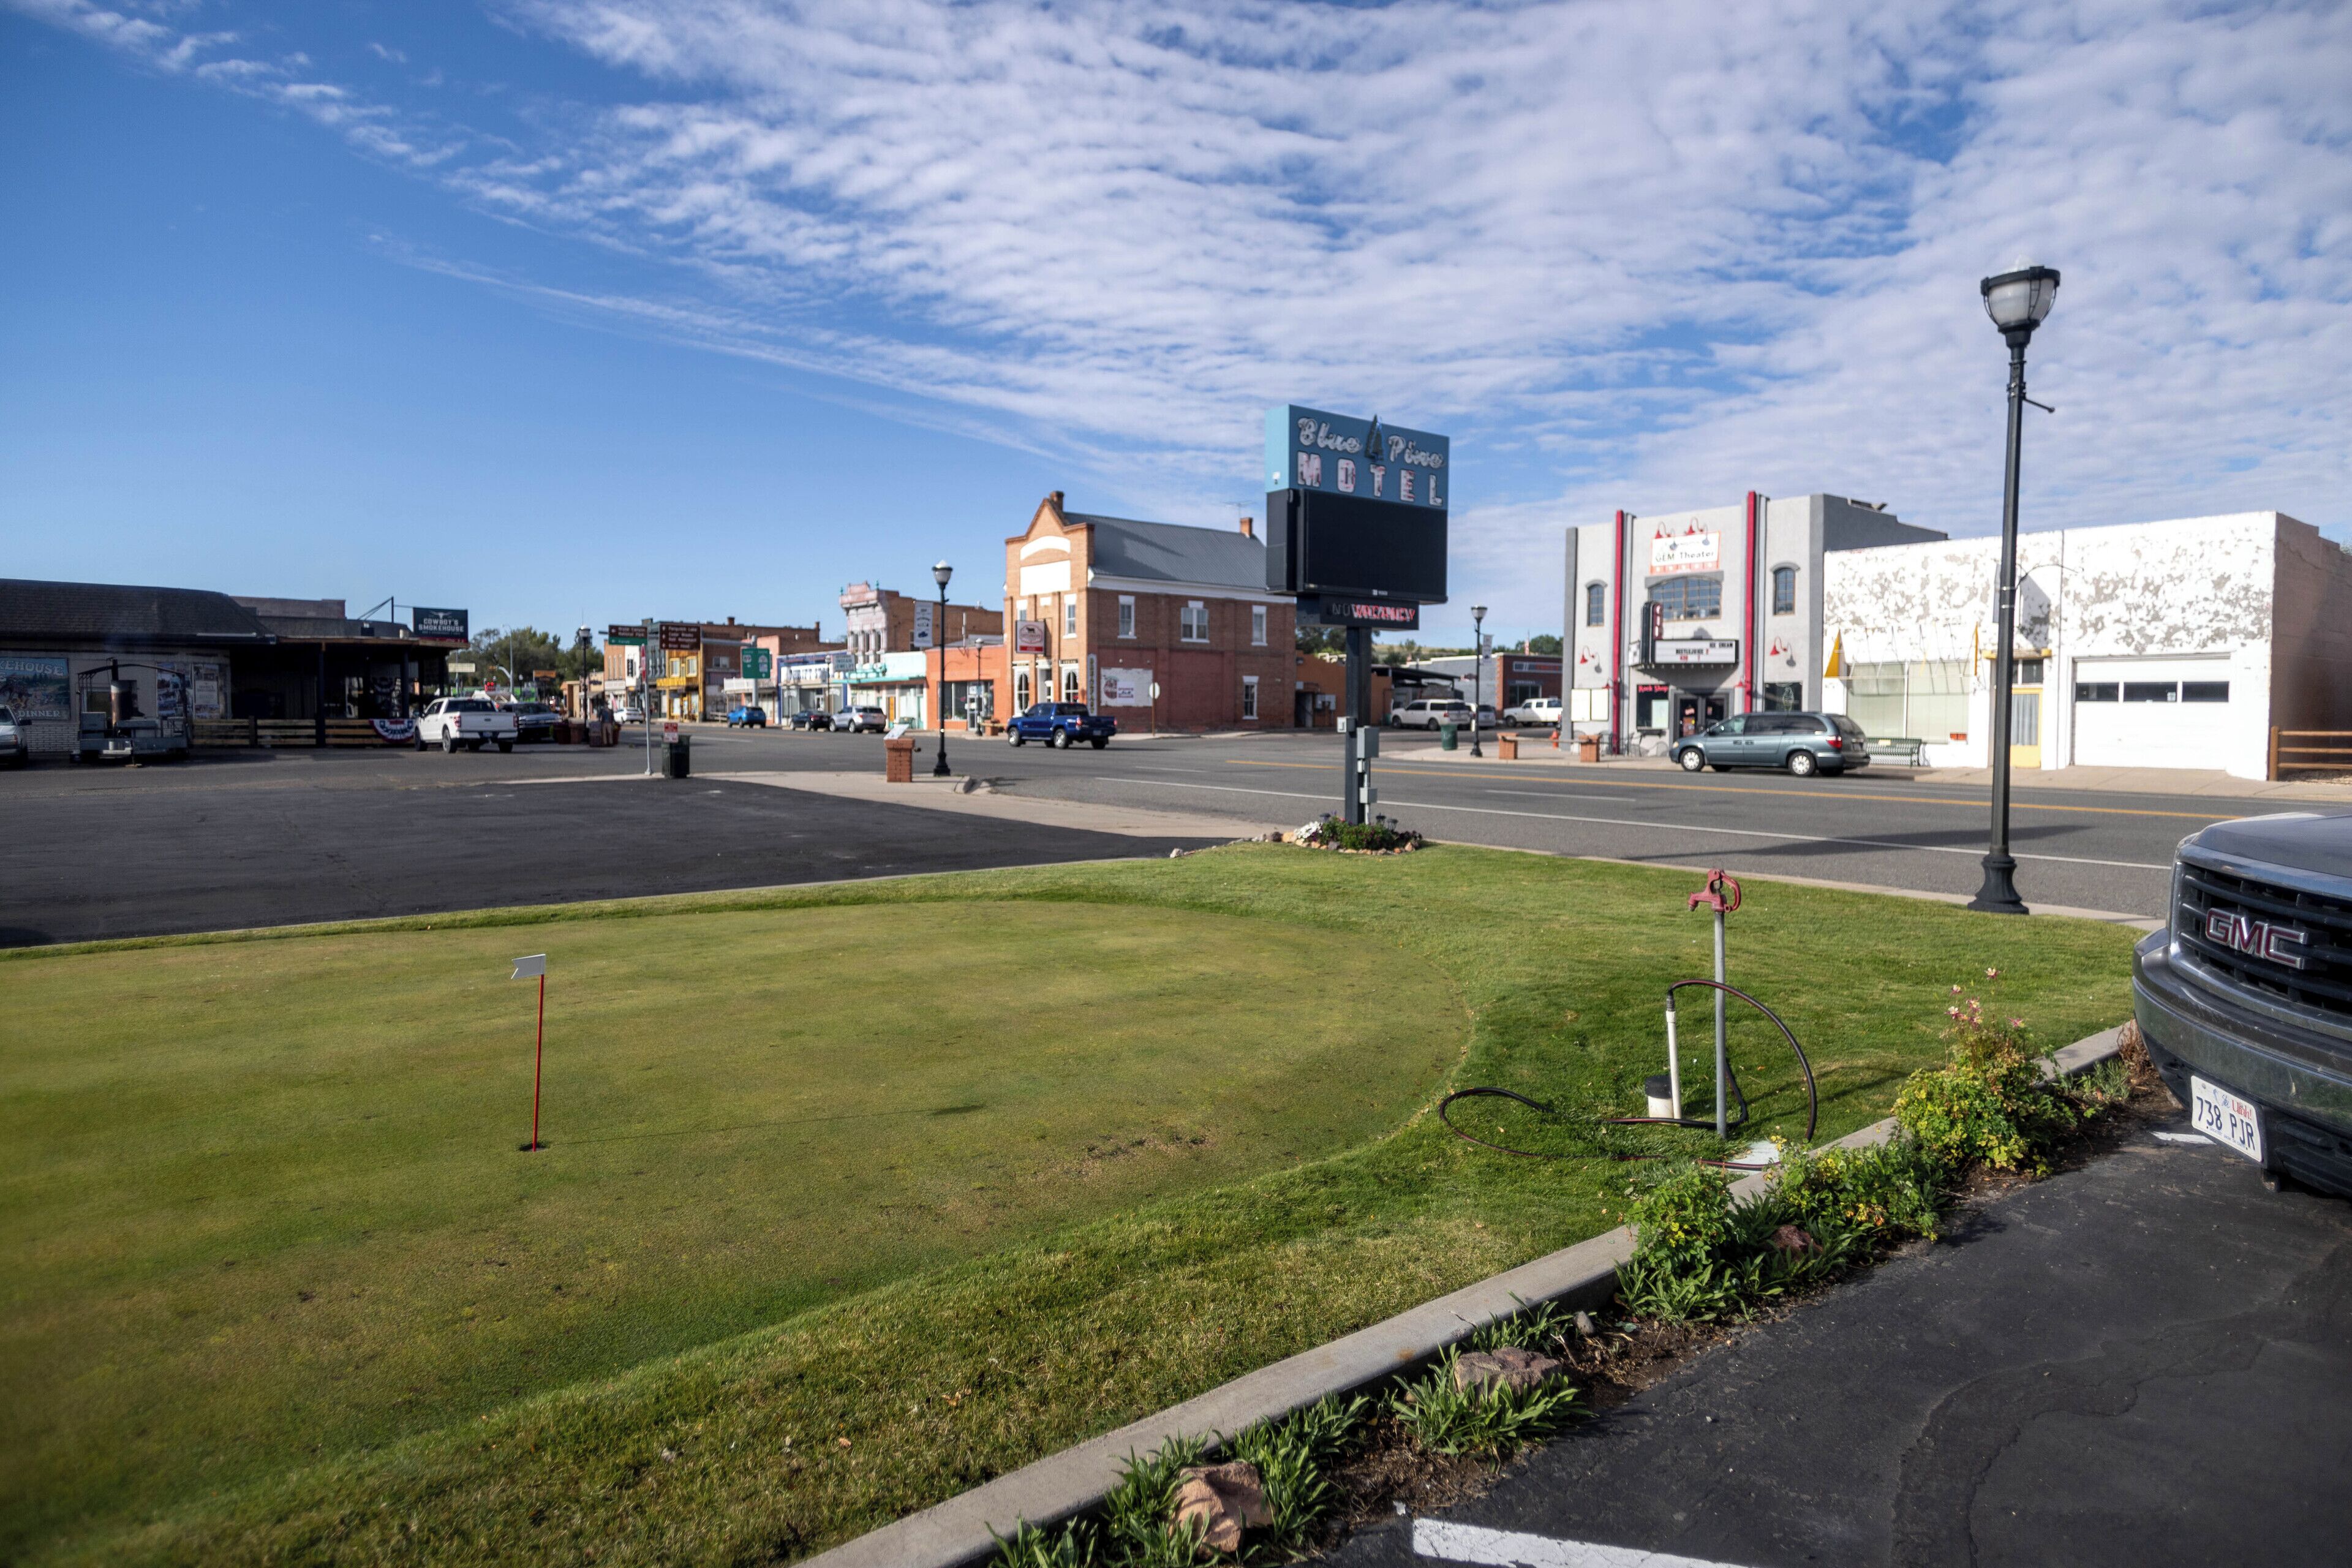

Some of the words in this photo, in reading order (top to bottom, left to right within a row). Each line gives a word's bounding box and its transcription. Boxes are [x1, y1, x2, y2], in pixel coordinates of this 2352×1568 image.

[1297, 417, 1362, 454] Blue
[1387, 435, 1444, 469] Pine
[1297, 451, 1443, 507] MOTEL
[418, 624, 464, 633] SMOKEHOUSE
[1351, 603, 1415, 622] VACANCY
[2205, 907, 2309, 970] GMC
[2196, 1096, 2223, 1131] 738
[2229, 1112, 2256, 1152] PJR
